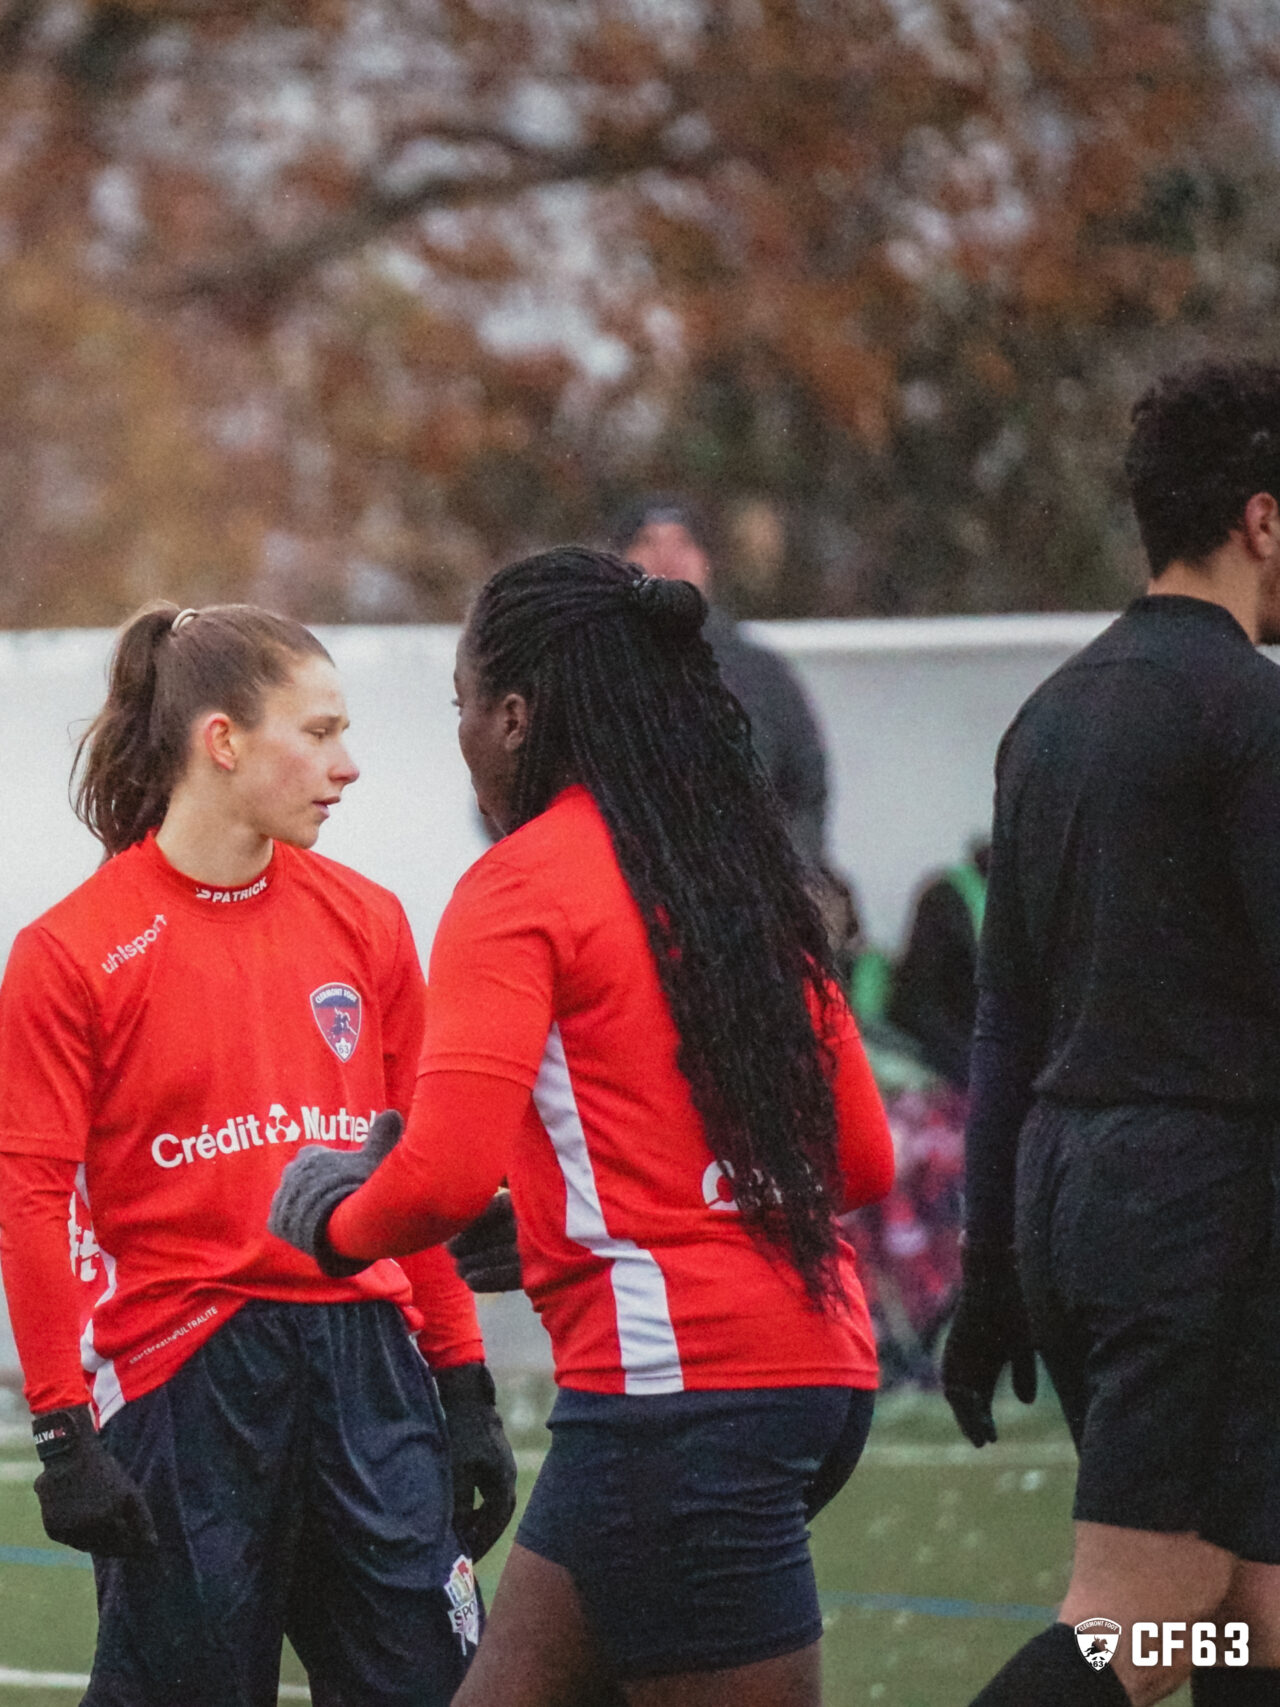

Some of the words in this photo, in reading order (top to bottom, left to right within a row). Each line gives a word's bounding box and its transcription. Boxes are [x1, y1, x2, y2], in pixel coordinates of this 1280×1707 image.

[212, 876, 268, 903] PATRICK
[101, 914, 168, 974] uhlsport
[151, 1113, 264, 1169] Crédit
